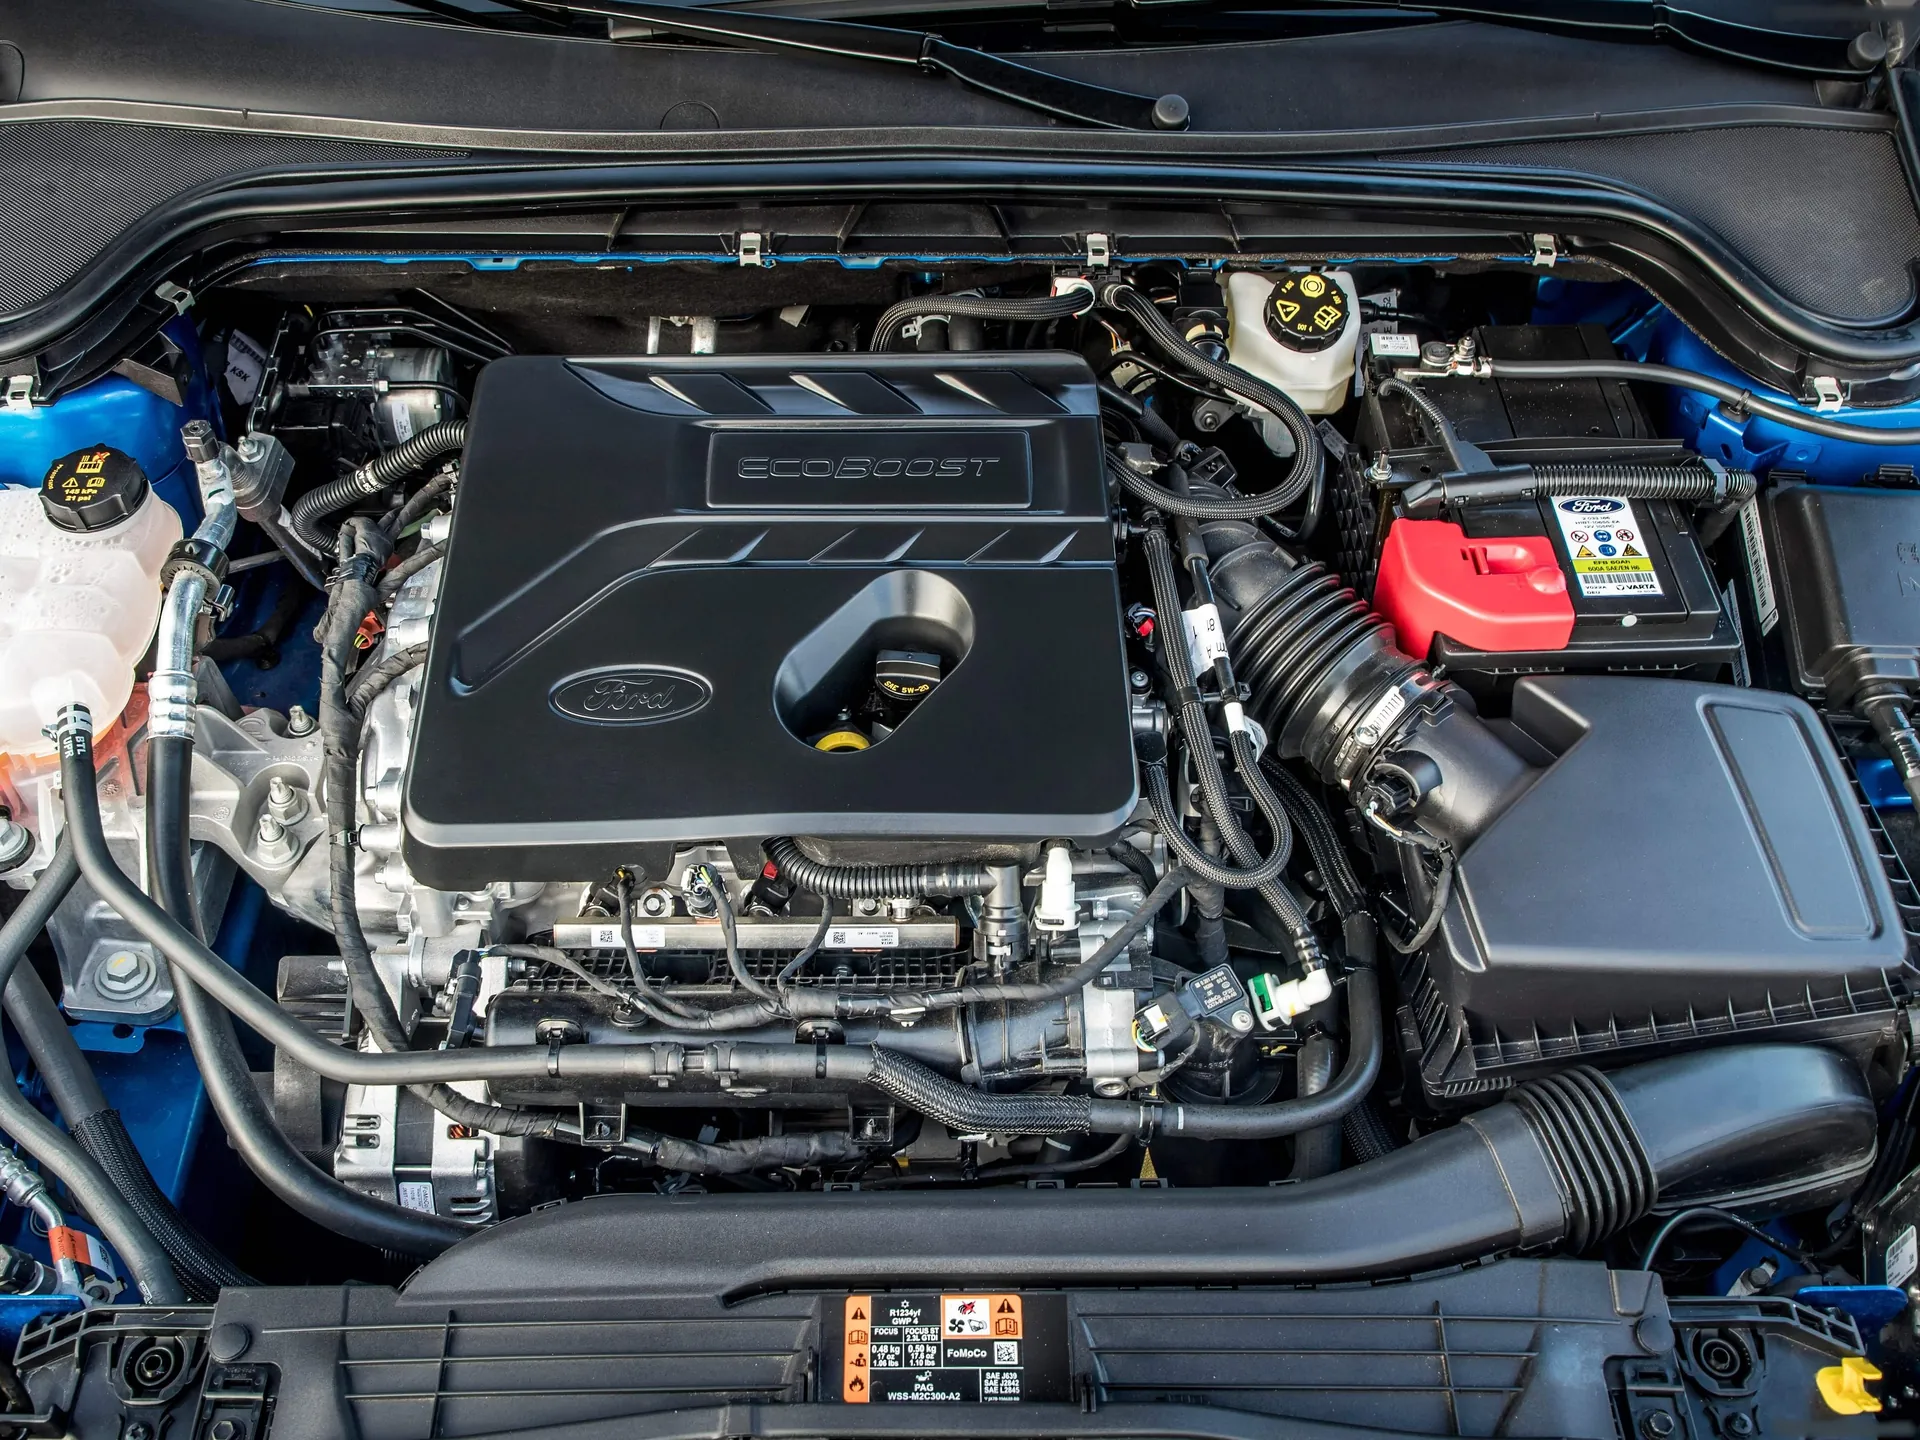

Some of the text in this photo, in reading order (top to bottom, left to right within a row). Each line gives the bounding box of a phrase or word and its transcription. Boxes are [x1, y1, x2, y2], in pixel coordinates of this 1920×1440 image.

[230, 366, 250, 382] KSK
[1572, 500, 1612, 512] Ford
[884, 680, 899, 691] SAE
[584, 678, 676, 711] Ford
[62, 736, 74, 759] UPR
[75, 736, 86, 755] BTL
[889, 1309, 921, 1317] R1234yf
[872, 1345, 900, 1355] 0.48 kg
[908, 1344, 937, 1354] 0.50 kg
[947, 1348, 987, 1358] FoMoCo
[914, 1384, 934, 1392] PAG
[888, 1392, 960, 1400] WSS-M2C300-A2
